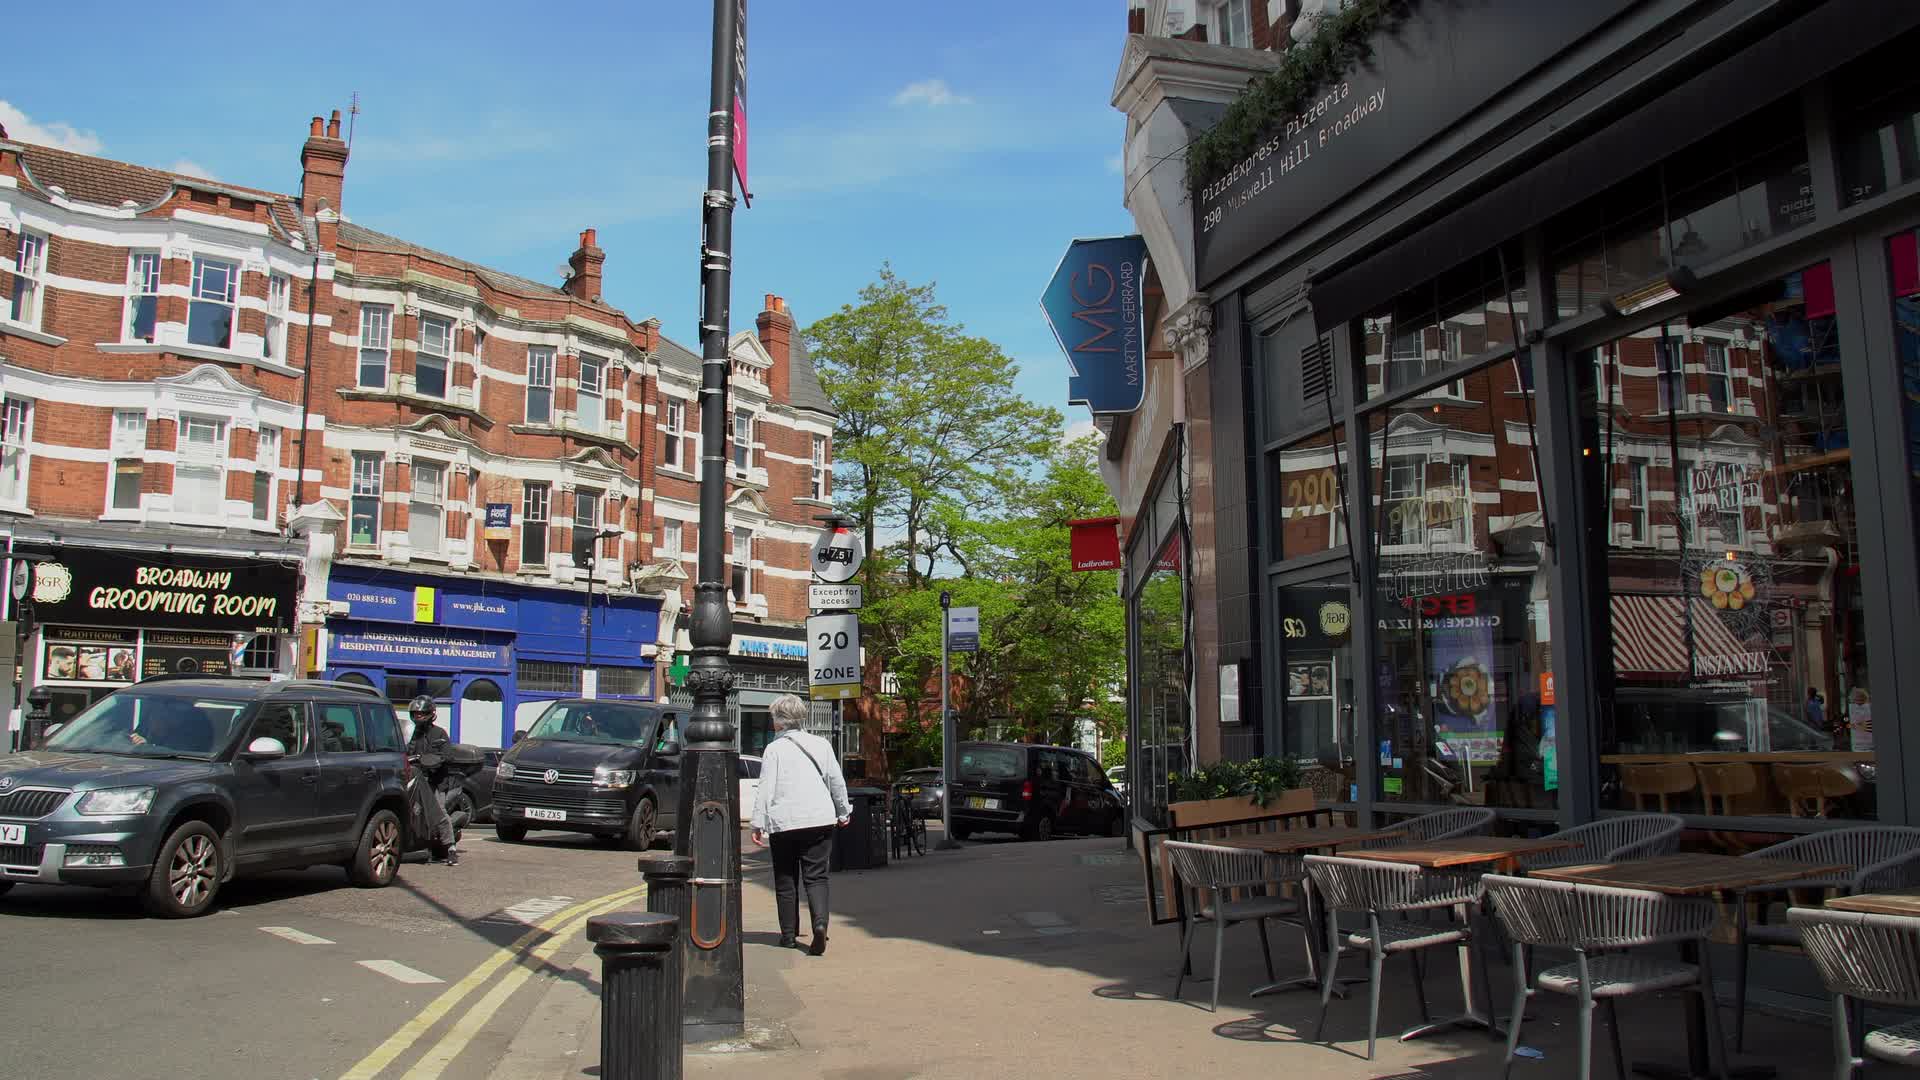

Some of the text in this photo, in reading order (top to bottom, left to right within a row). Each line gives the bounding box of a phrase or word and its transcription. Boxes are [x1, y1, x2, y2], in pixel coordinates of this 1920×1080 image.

[1202, 81, 1349, 205] PizzaExpress Pizzeria
[1203, 87, 1386, 232] 290 Muswell Hill Broadway
[1069, 263, 1121, 352] MG
[1120, 261, 1138, 386] MARTYN GERRARD
[1289, 468, 1336, 520] 290
[1078, 560, 1114, 568] Ladbrokes
[136, 567, 231, 590] BROADWAY
[347, 593, 361, 601] 020
[361, 594, 379, 603] 8883
[812, 588, 858, 597] Except for
[89, 586, 277, 617] GROOMING ROOM
[452, 603, 506, 614] www.jhk.co.uk
[820, 597, 850, 605] access
[58, 630, 125, 641] TRADITIONAL
[152, 634, 227, 646] TURKISH BARBER
[363, 632, 478, 647] INDEPENDENT ESTATE AGENTS
[817, 631, 849, 650] 20
[340, 642, 497, 659] RESIDENTIAL LETTINGS & MANAGEMENT
[814, 666, 855, 680] ZONE
